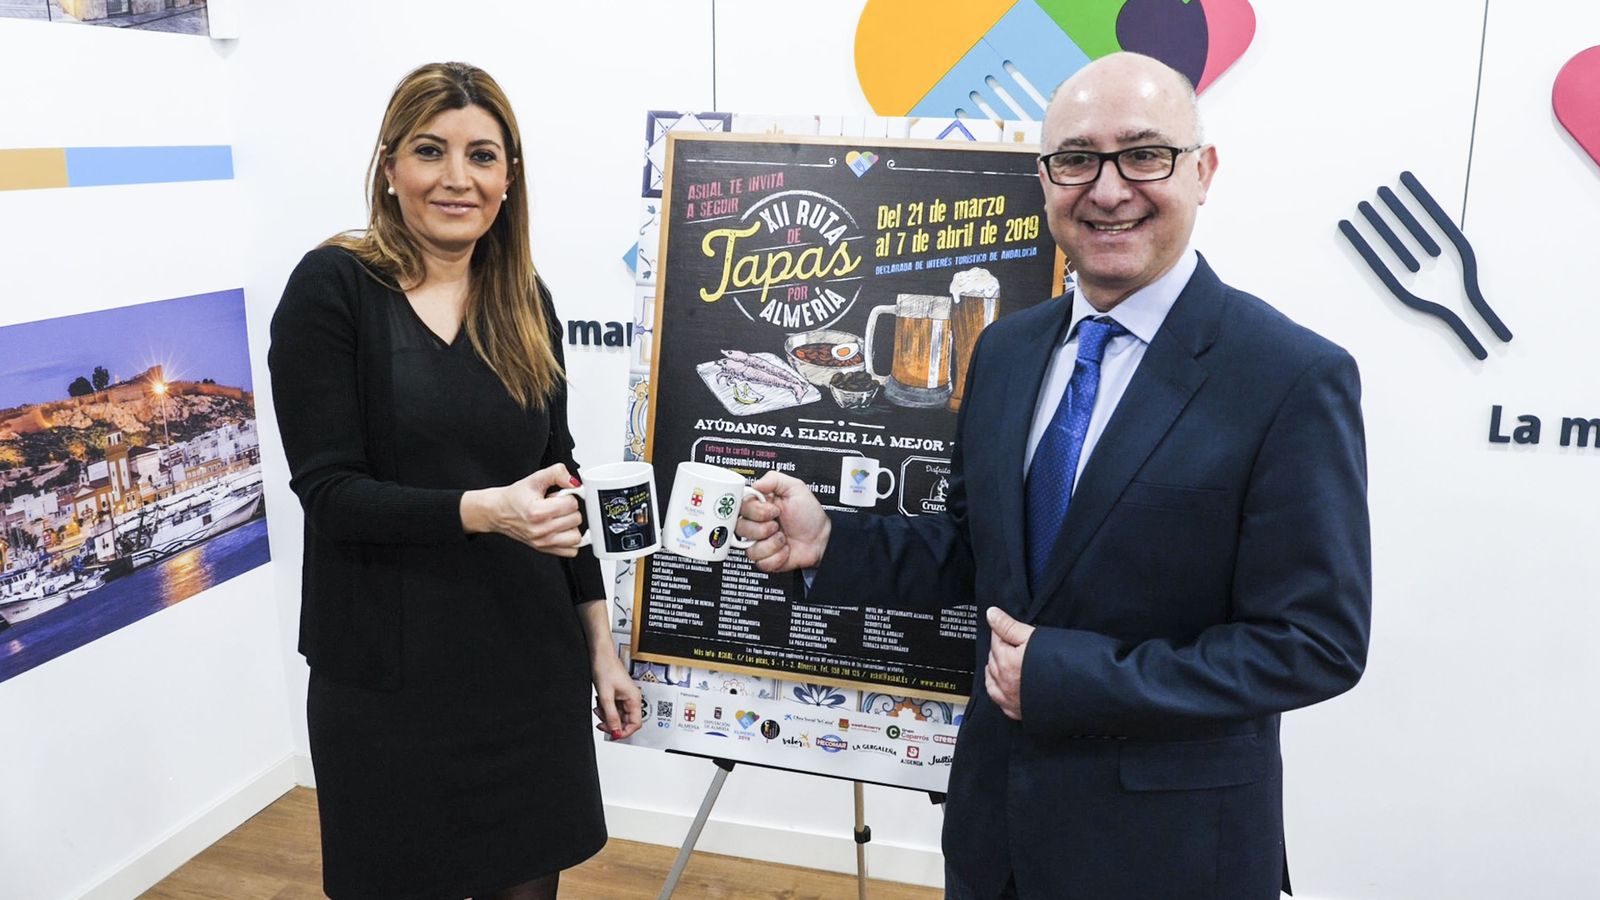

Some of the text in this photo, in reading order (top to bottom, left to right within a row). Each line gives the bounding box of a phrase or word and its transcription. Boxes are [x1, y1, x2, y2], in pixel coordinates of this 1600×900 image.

[730, 178, 743, 195] TE
[748, 172, 785, 192] INVITA
[686, 198, 739, 219] A SEGUIR
[759, 200, 848, 246] XII RUTA
[877, 195, 1005, 230] Del 21 de marzo
[787, 228, 801, 244] DE
[875, 215, 1040, 258] al 7 de abril de 2019
[700, 221, 862, 302] Tapas
[875, 246, 1038, 275] DECLARADA DE INTERÉS TURÍSTICO DE ANDALUCÍA
[759, 287, 847, 328] ALMERÍA
[788, 286, 808, 302] POR
[694, 418, 944, 452] AYÚDANOS A ELEGIR LA MEJOR
[1488, 405, 1542, 444] La
[705, 454, 796, 472] Por 5 consumiciones 1 gratis
[820, 483, 836, 494] 2019
